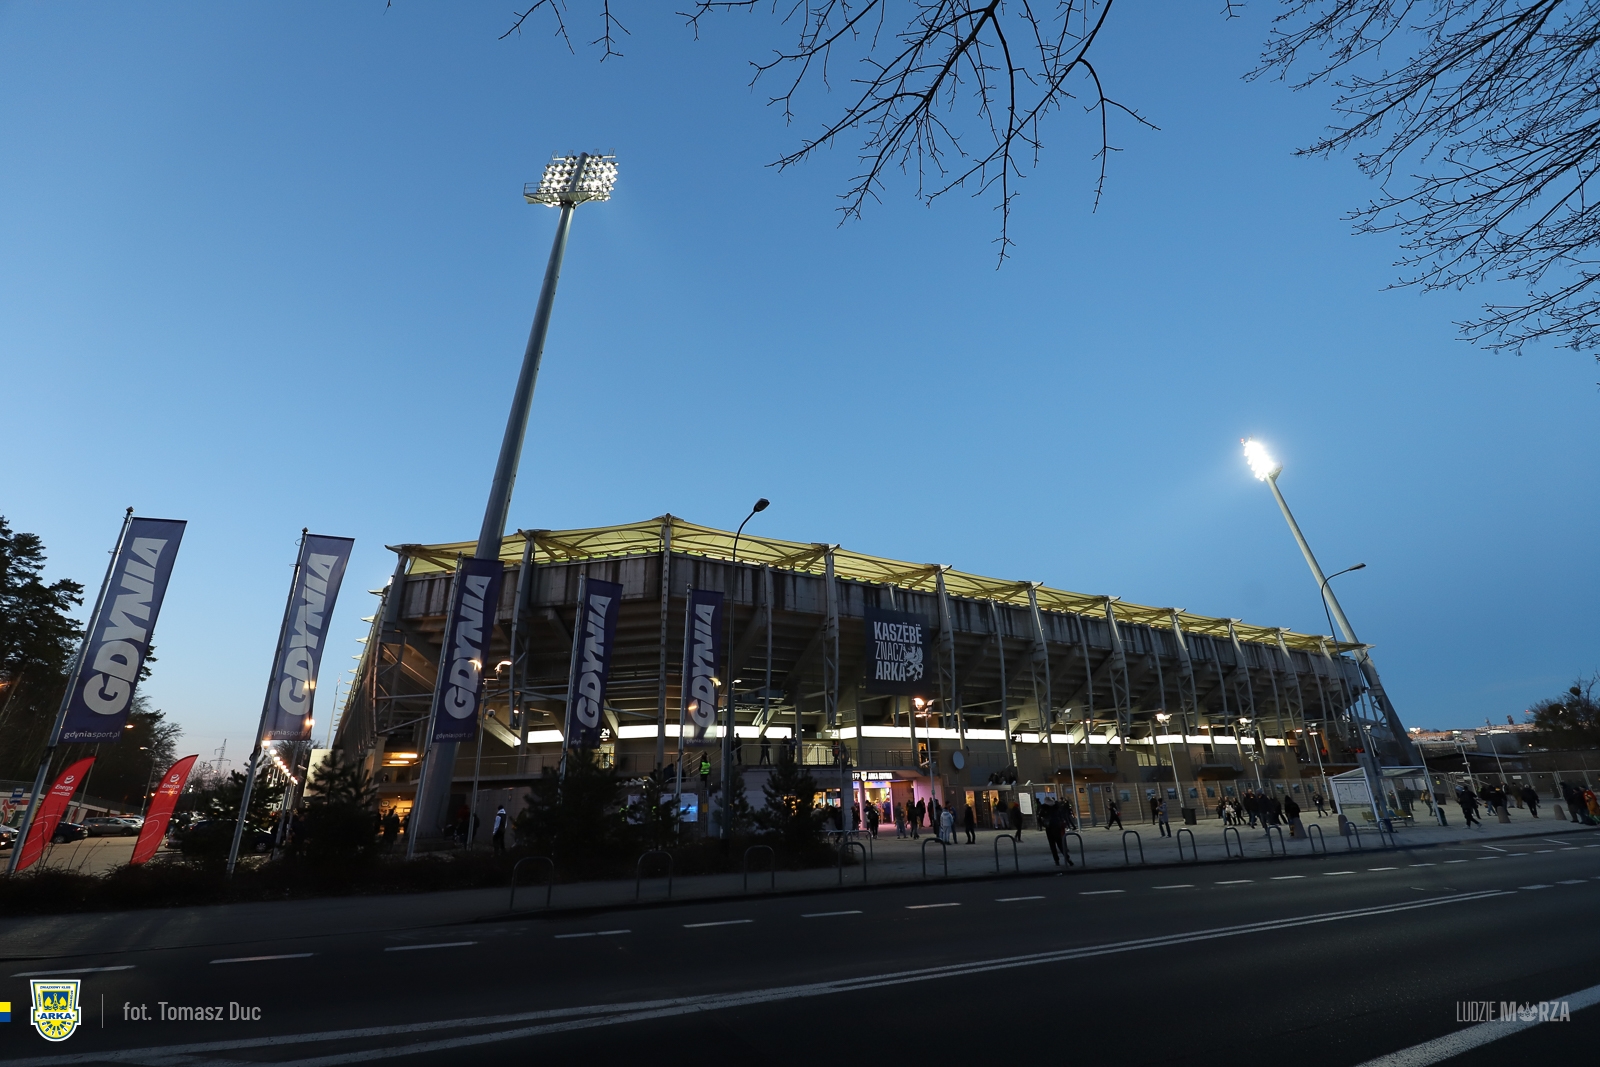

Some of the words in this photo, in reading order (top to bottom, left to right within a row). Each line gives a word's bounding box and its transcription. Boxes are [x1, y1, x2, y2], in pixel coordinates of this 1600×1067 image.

[83, 536, 168, 715] GDYNIA
[278, 553, 339, 716] GDYNIA
[444, 574, 492, 719] GDYNIA
[576, 595, 612, 729] GDYNIA
[873, 621, 923, 645] KASZËBË
[690, 603, 716, 728] GDYNIA
[875, 661, 907, 682] ARKA
[63, 730, 121, 740] gdyniasport.pl
[600, 727, 611, 736] 24
[54, 783, 74, 791] Energa
